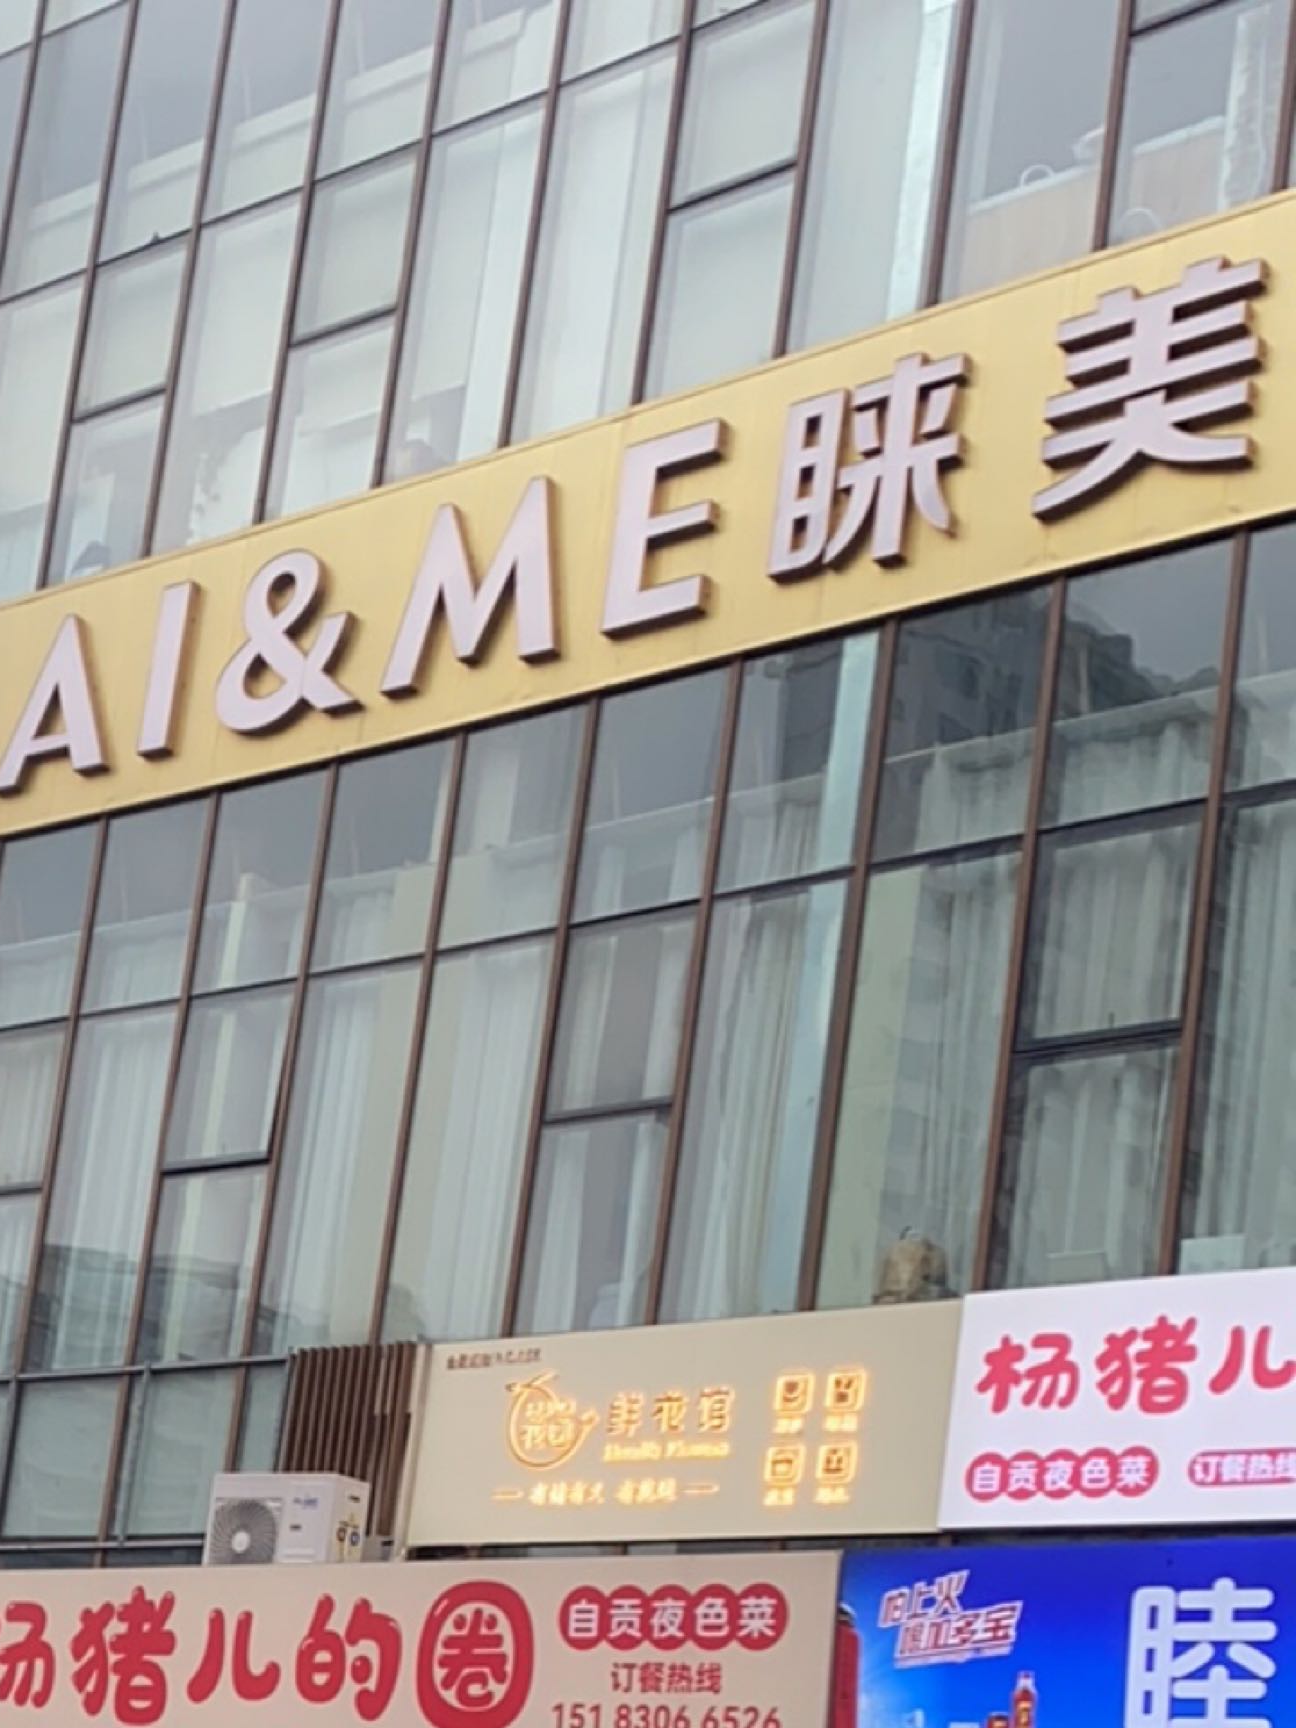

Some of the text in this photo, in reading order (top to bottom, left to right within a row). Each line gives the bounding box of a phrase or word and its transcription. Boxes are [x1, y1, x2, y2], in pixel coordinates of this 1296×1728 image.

[765, 257, 1267, 580] 睐美
[970, 1453, 1150, 1494] 自贡夜色菜
[566, 1595, 779, 1639] 自贡夜色菜
[611, 1661, 722, 1695] 订餐热线
